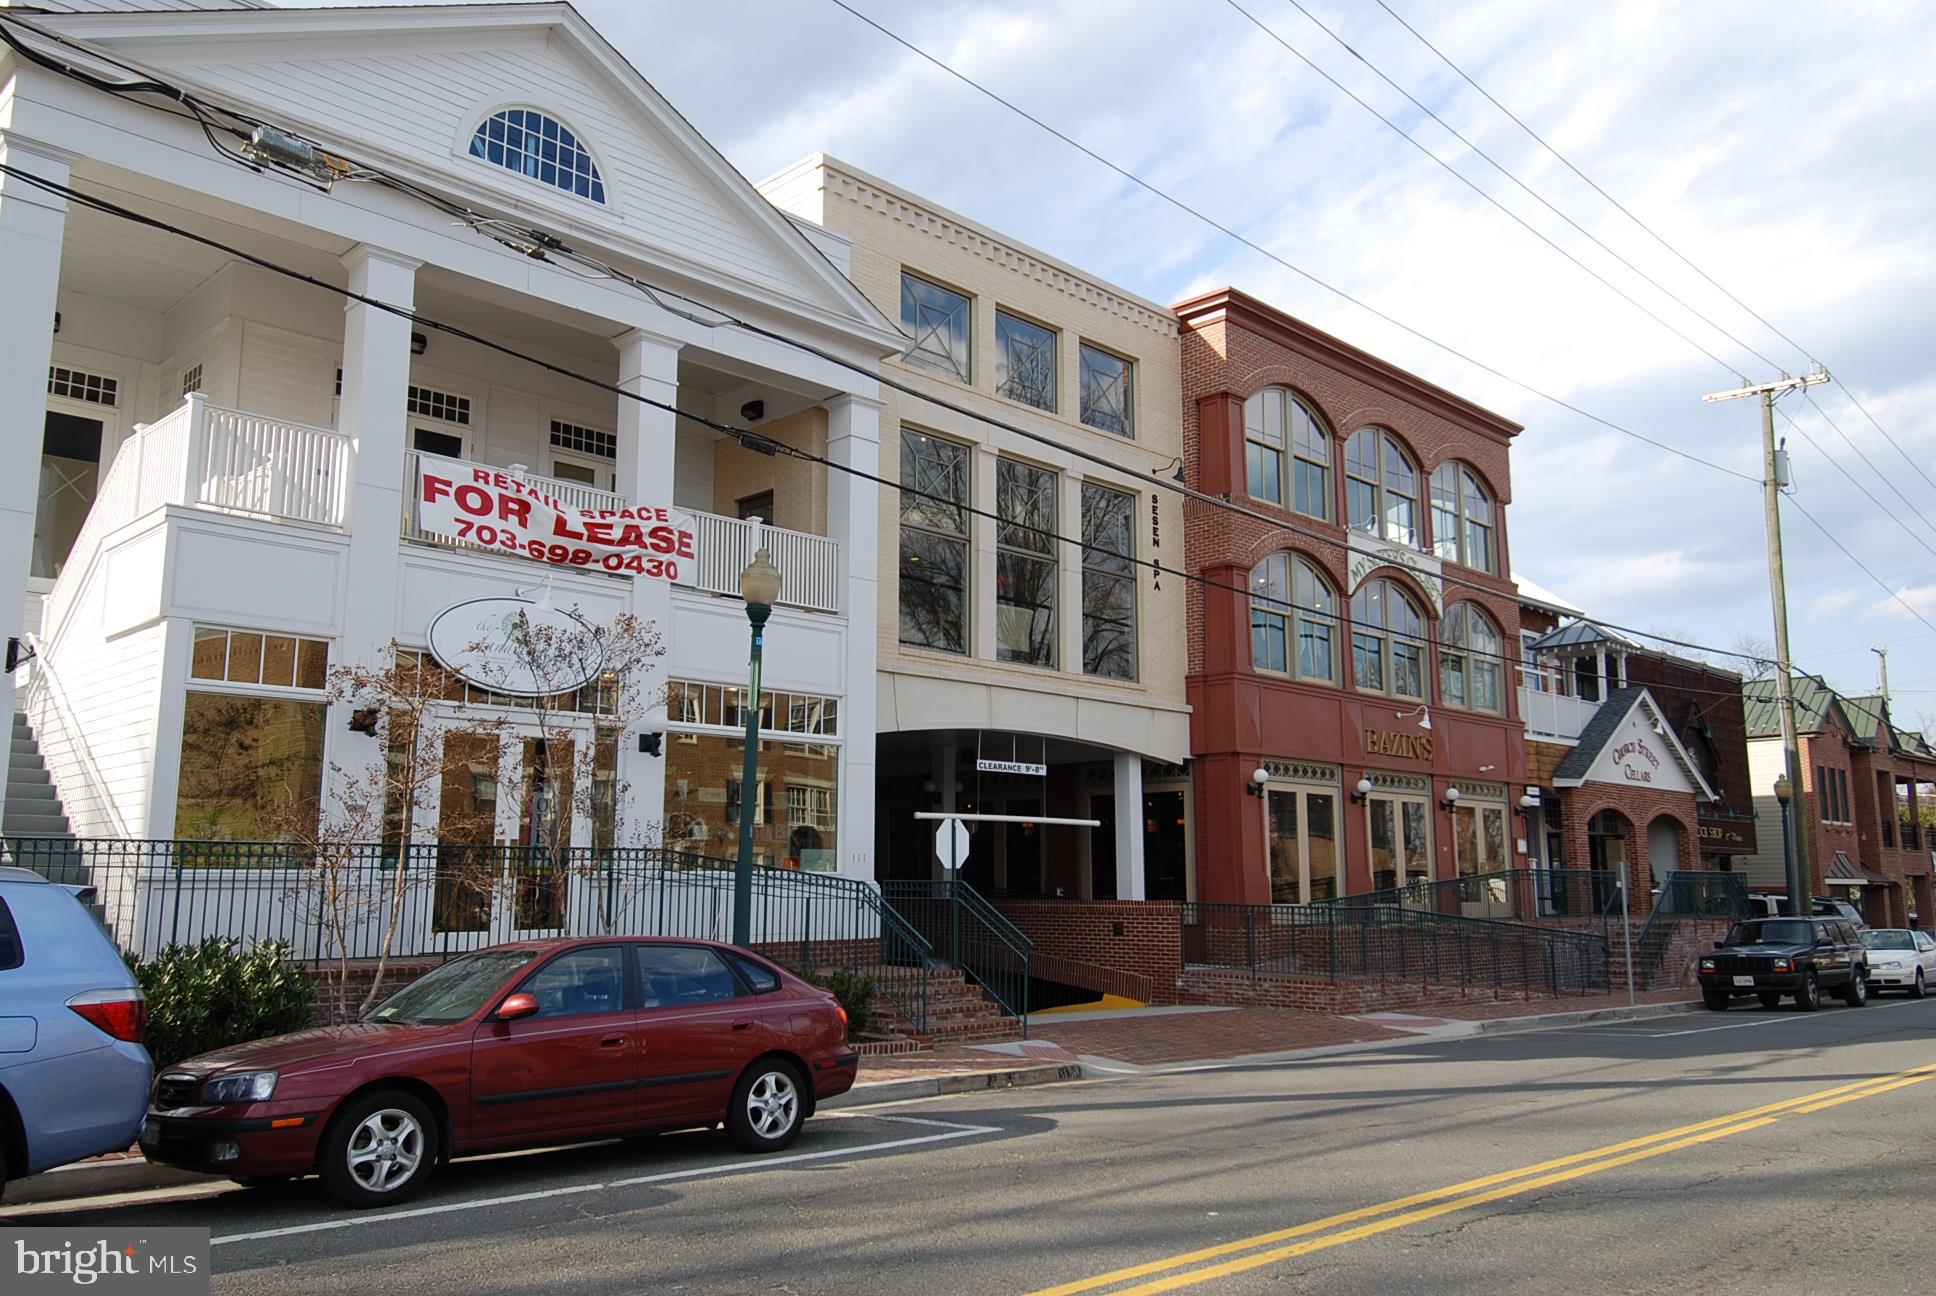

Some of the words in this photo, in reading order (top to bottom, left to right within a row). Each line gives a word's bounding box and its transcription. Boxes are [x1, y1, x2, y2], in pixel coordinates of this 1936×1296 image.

[473, 468, 566, 515] RETAIL
[579, 506, 669, 523] SPACE
[423, 473, 532, 530] FOR
[552, 514, 695, 560] LEASE
[454, 517, 678, 581] 703-698-0430
[1153, 559, 1161, 591] SPA
[1350, 557, 1366, 584] MY
[1365, 728, 1433, 761] BAZIN'S
[978, 762, 1022, 772] CLEARANCE
[1624, 763, 1651, 782] CELLARS
